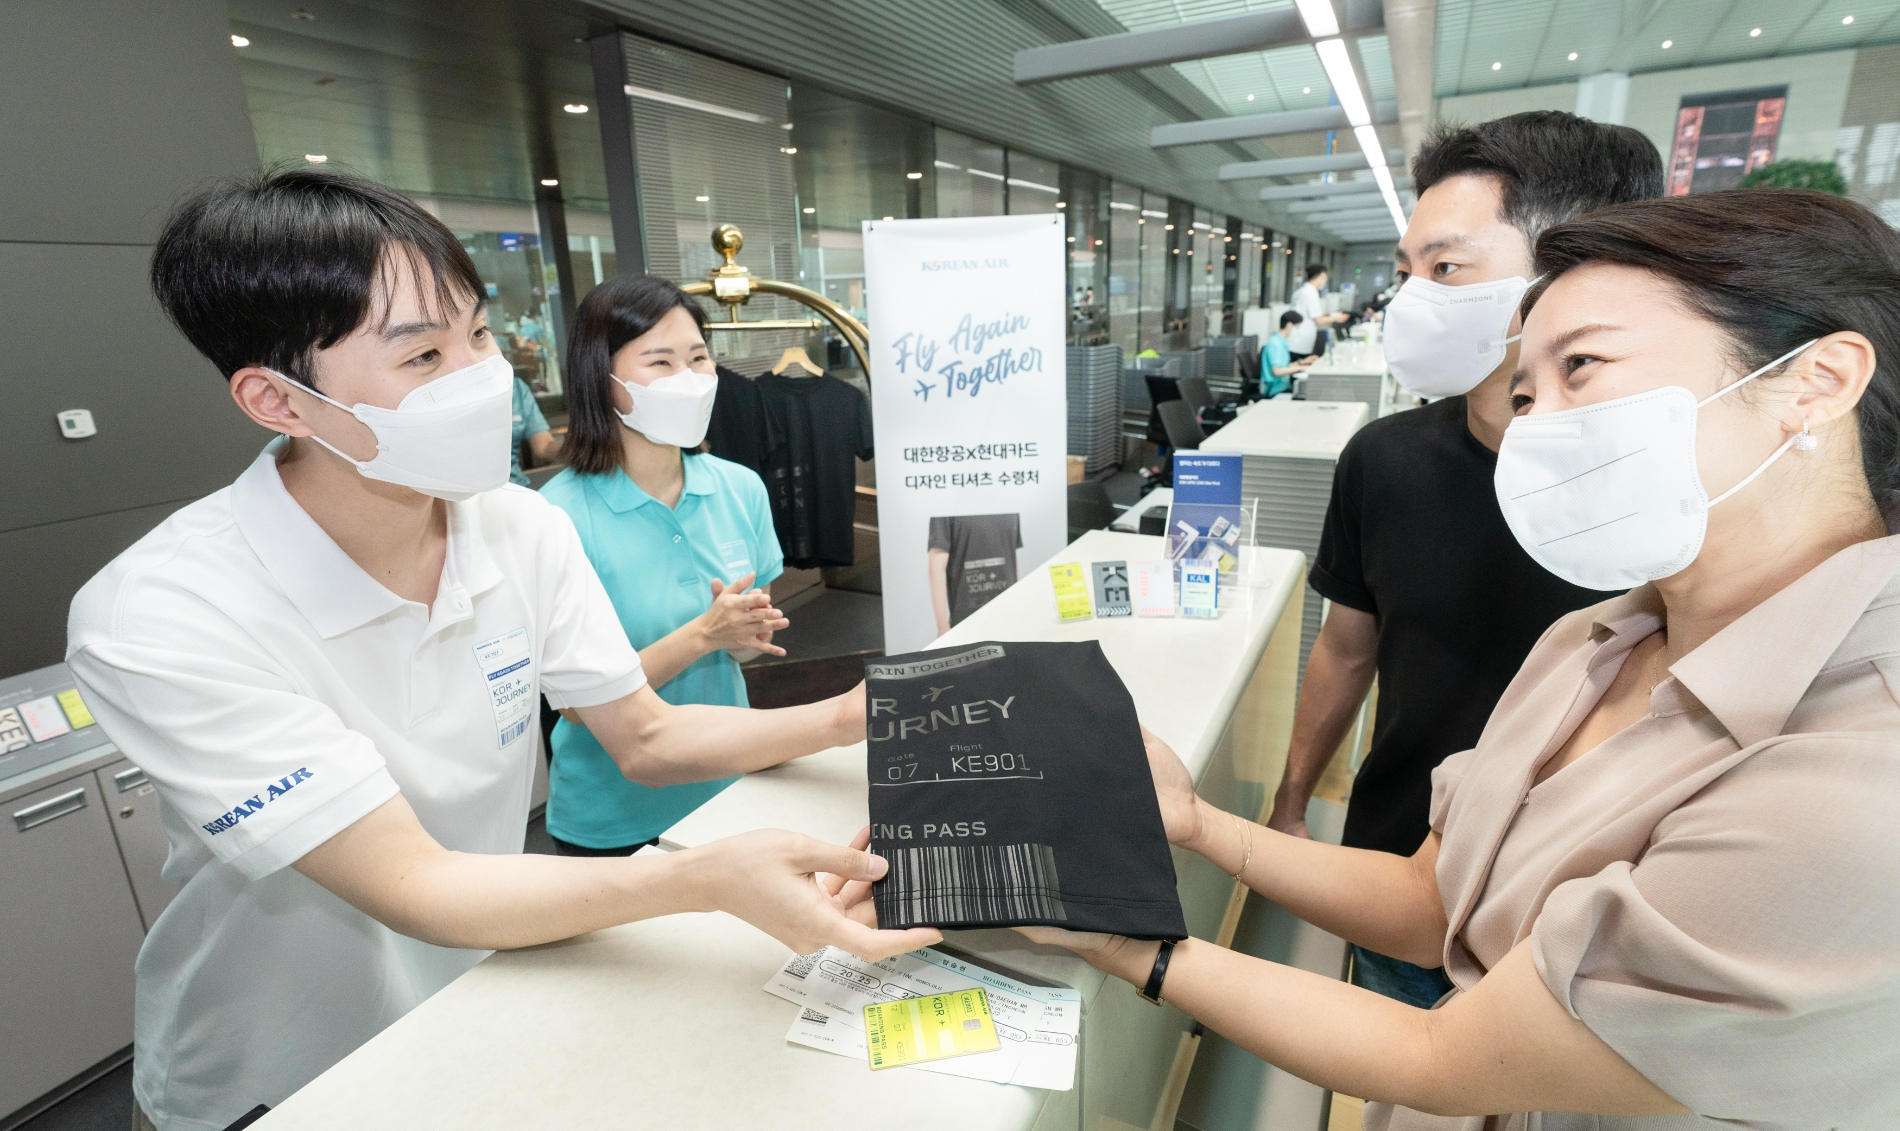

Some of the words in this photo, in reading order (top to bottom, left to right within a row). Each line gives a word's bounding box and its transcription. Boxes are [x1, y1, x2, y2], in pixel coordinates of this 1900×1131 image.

[922, 260, 978, 271] KOREAN
[983, 258, 1009, 269] AIR
[1449, 295, 1494, 305] CHARMZONE
[892, 332, 940, 374] Fly
[948, 311, 1031, 355] Again
[938, 346, 1043, 398] Together
[905, 474, 946, 490] 디자인
[951, 472, 993, 488] 티셔츠
[998, 470, 1039, 486] 수령처
[1189, 574, 1207, 583] KAL
[910, 648, 999, 672] TOGETHER
[492, 682, 512, 697] KOR
[496, 681, 532, 707] JOURNEY
[887, 753, 915, 763] Gate
[950, 743, 983, 753] Flight
[888, 763, 919, 780] 07
[951, 753, 1031, 773] KE901
[202, 794, 265, 836] KOREAN
[266, 767, 314, 802] AIR
[923, 821, 987, 839] PASS
[982, 975, 1016, 992] BOARDING
[1016, 987, 1032, 996] PASS
[932, 997, 945, 1017] KOR
[876, 1006, 885, 1034] BOARDING
[894, 1023, 901, 1032] 07
